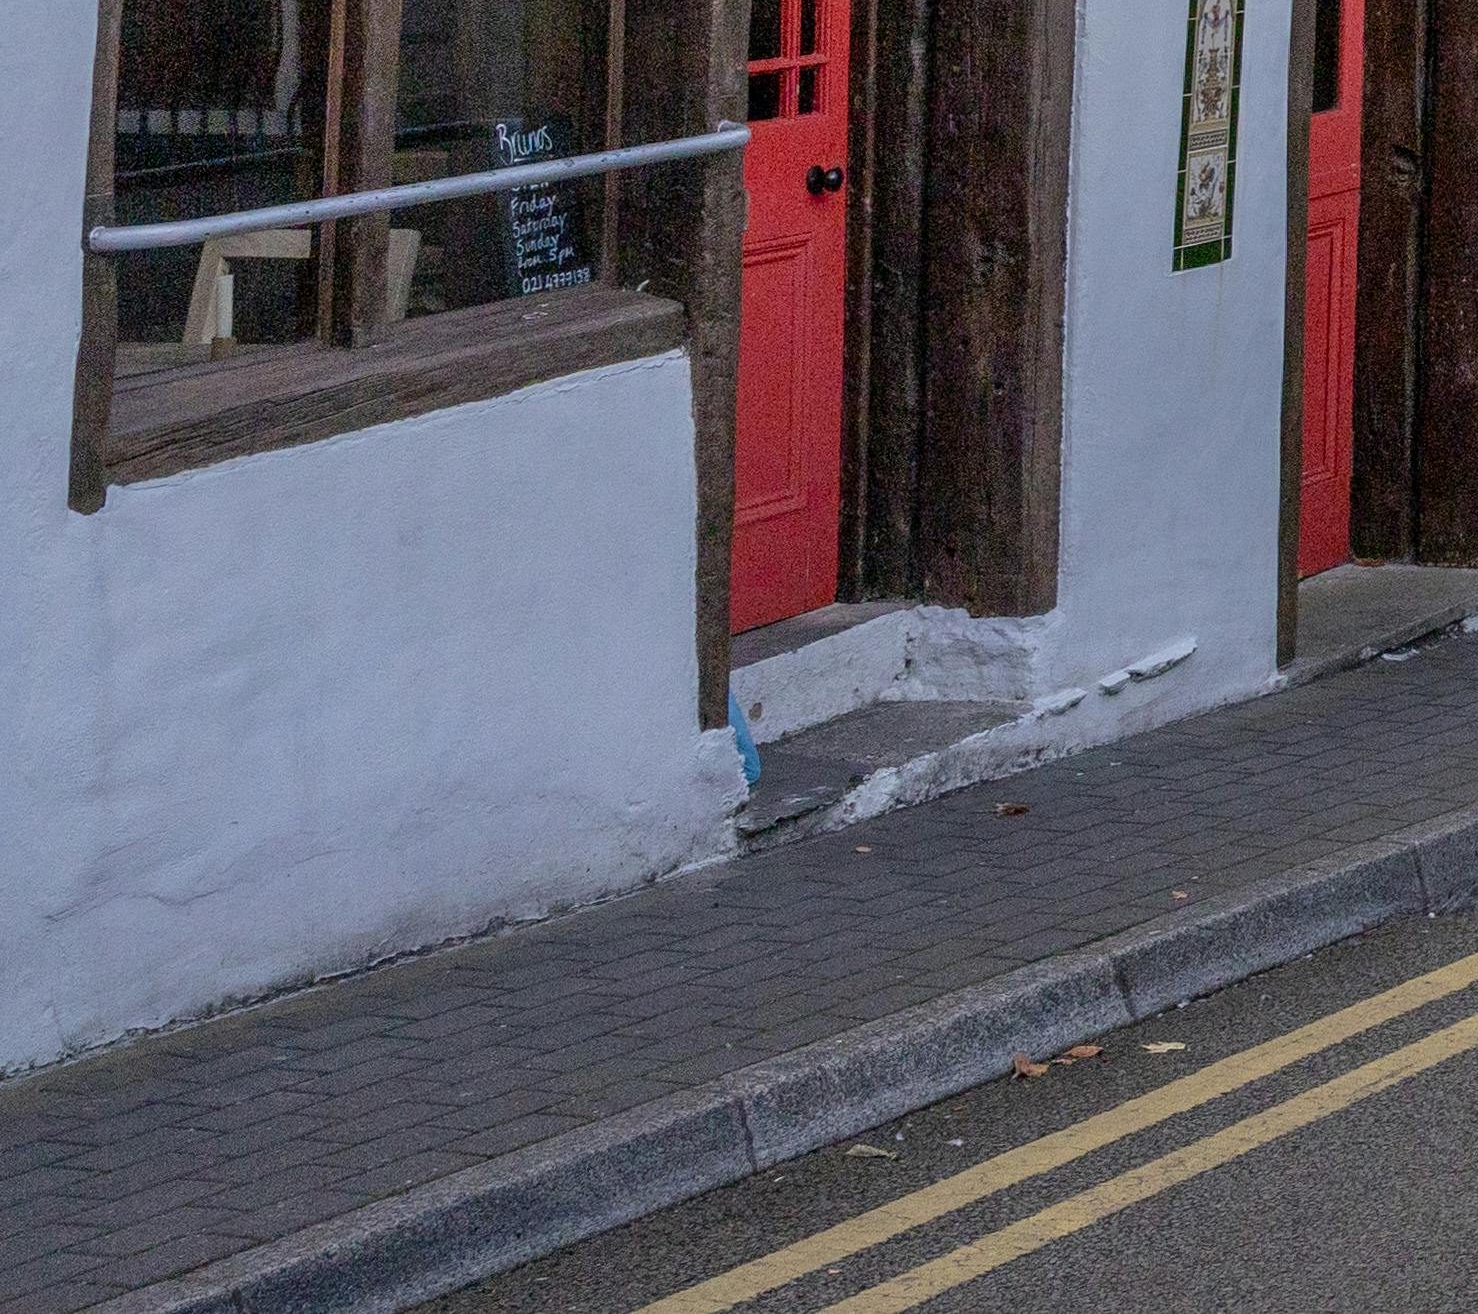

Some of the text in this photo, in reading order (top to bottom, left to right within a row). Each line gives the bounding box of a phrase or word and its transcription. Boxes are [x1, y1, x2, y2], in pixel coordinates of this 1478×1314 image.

[511, 194, 557, 218] Friday
[512, 212, 568, 239] Saturday
[516, 233, 559, 257] Sunday
